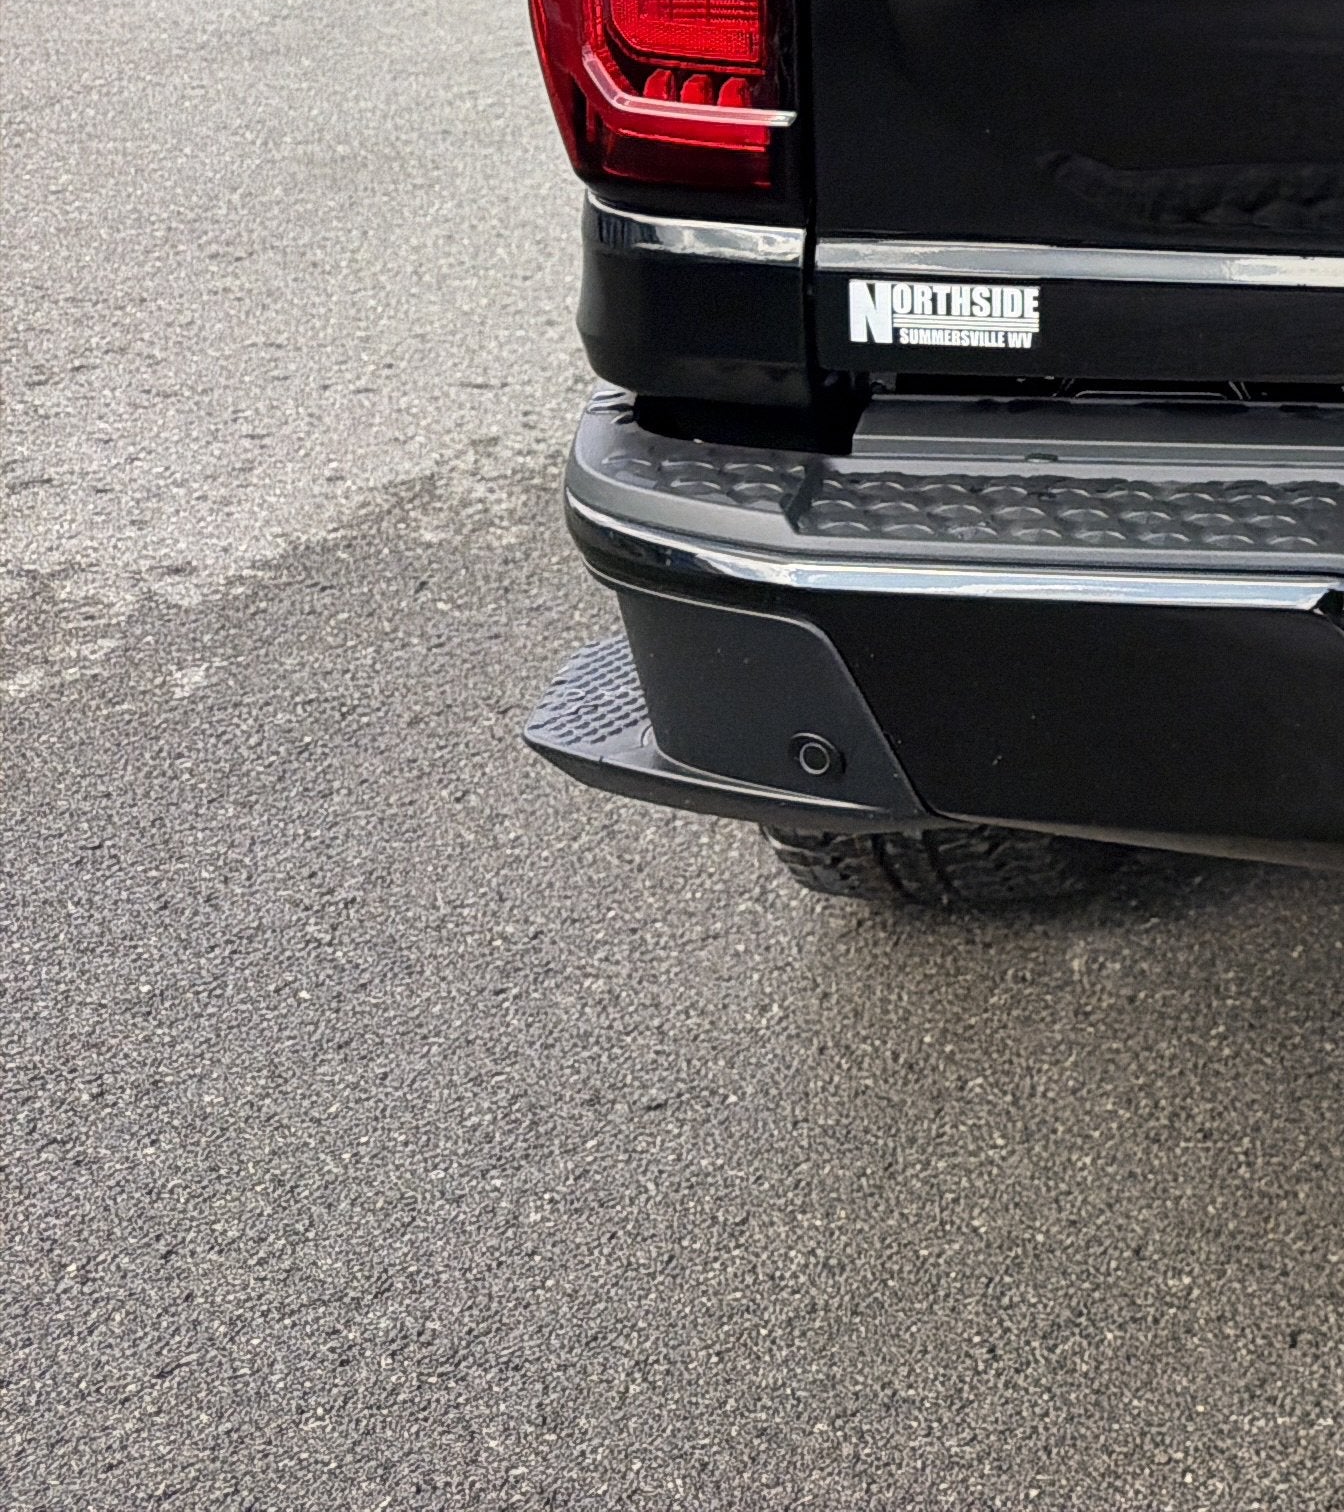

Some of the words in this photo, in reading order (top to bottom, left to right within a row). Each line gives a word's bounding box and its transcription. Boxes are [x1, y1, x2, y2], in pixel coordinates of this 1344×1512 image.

[848, 278, 1040, 344] NORTHSIDE
[899, 329, 1006, 349] SUMMERSVILLE
[1008, 332, 1033, 349] WV
